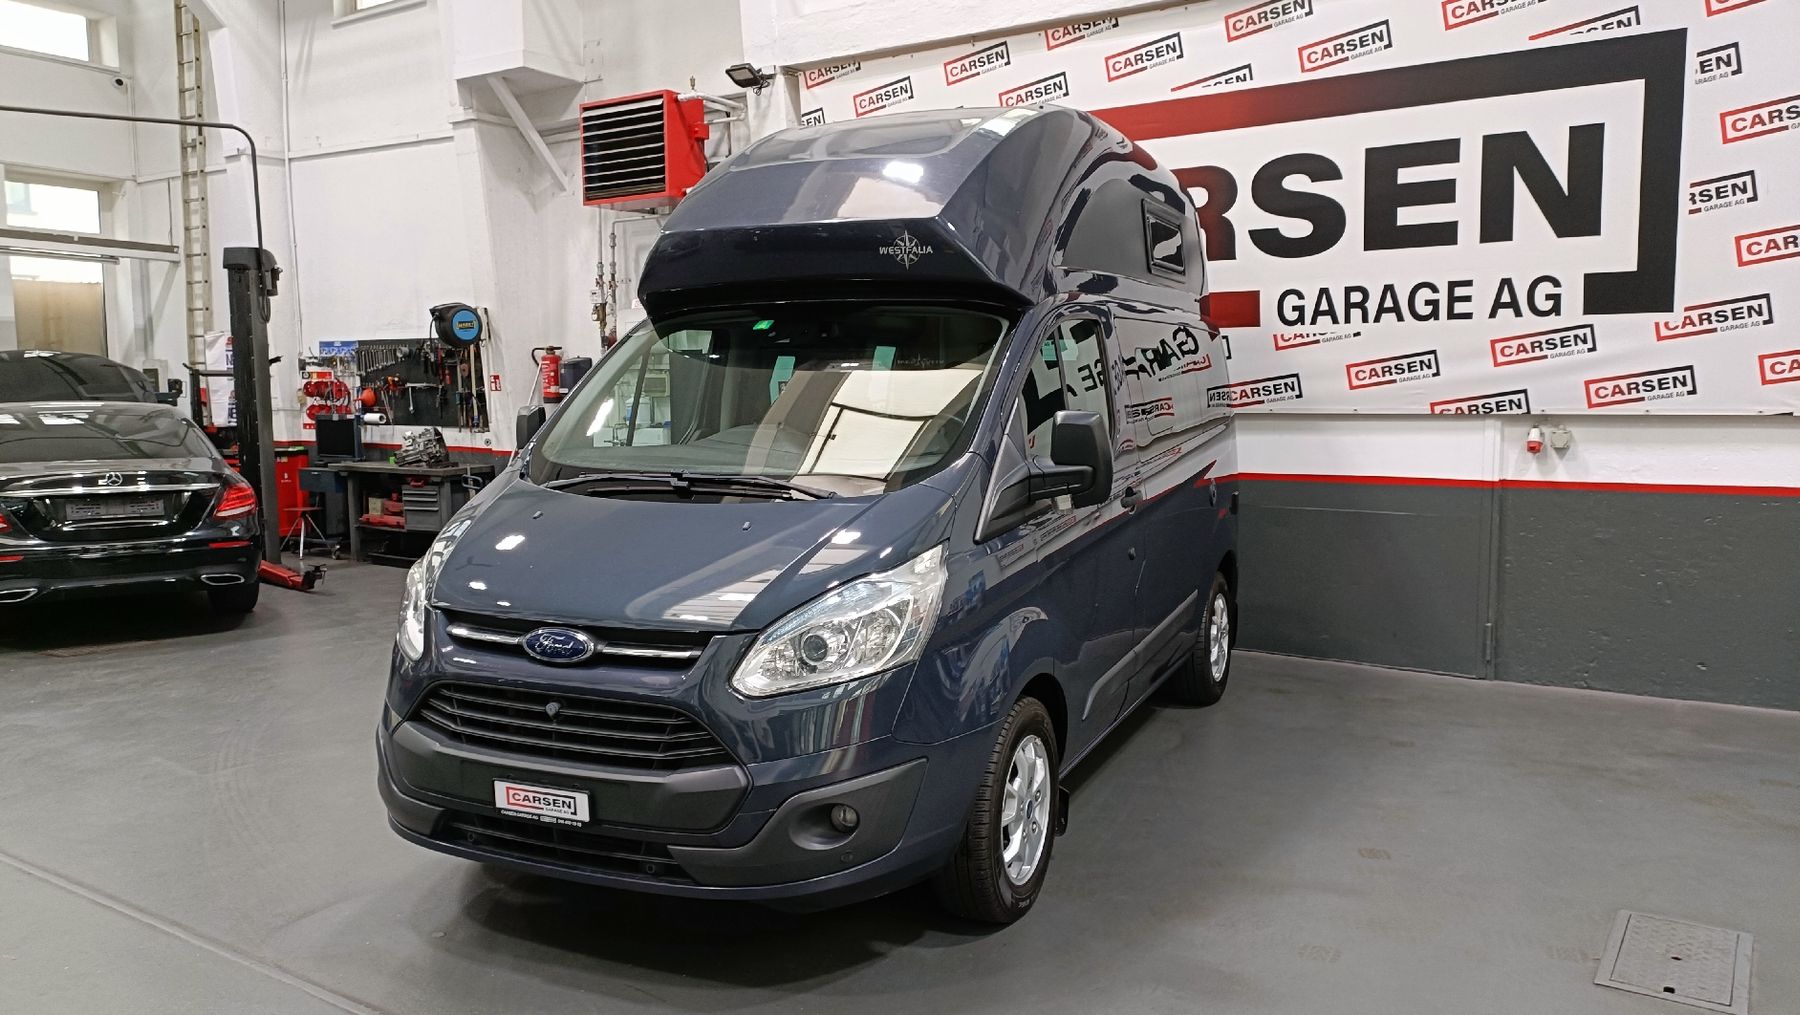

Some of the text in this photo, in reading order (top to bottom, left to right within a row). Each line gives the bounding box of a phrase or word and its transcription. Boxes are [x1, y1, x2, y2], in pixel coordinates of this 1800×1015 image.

[1232, 0, 1305, 32] CARSEN
[1451, 0, 1521, 19] CAR
[1112, 41, 1177, 72] CARSEN
[1307, 29, 1385, 64] CARSEN
[949, 49, 1005, 77] CARSEN
[859, 84, 909, 109] CARSEN
[1005, 80, 1063, 107] CARSEN
[1731, 105, 1800, 132] CARS
[1172, 122, 1605, 261] RSEN
[1703, 200, 1733, 212] GARAGE
[879, 245, 933, 255] WESTFALIA
[1746, 234, 1799, 256] CAR
[1276, 274, 1563, 327] GARAGE AG
[1663, 303, 1764, 331] CARSEN
[1720, 322, 1748, 332] GARAGE
[1500, 332, 1588, 358] CARSEN
[1354, 358, 1433, 382] CARSEN
[1594, 374, 1688, 399] CARSEN
[512, 792, 572, 809] CARSEN
